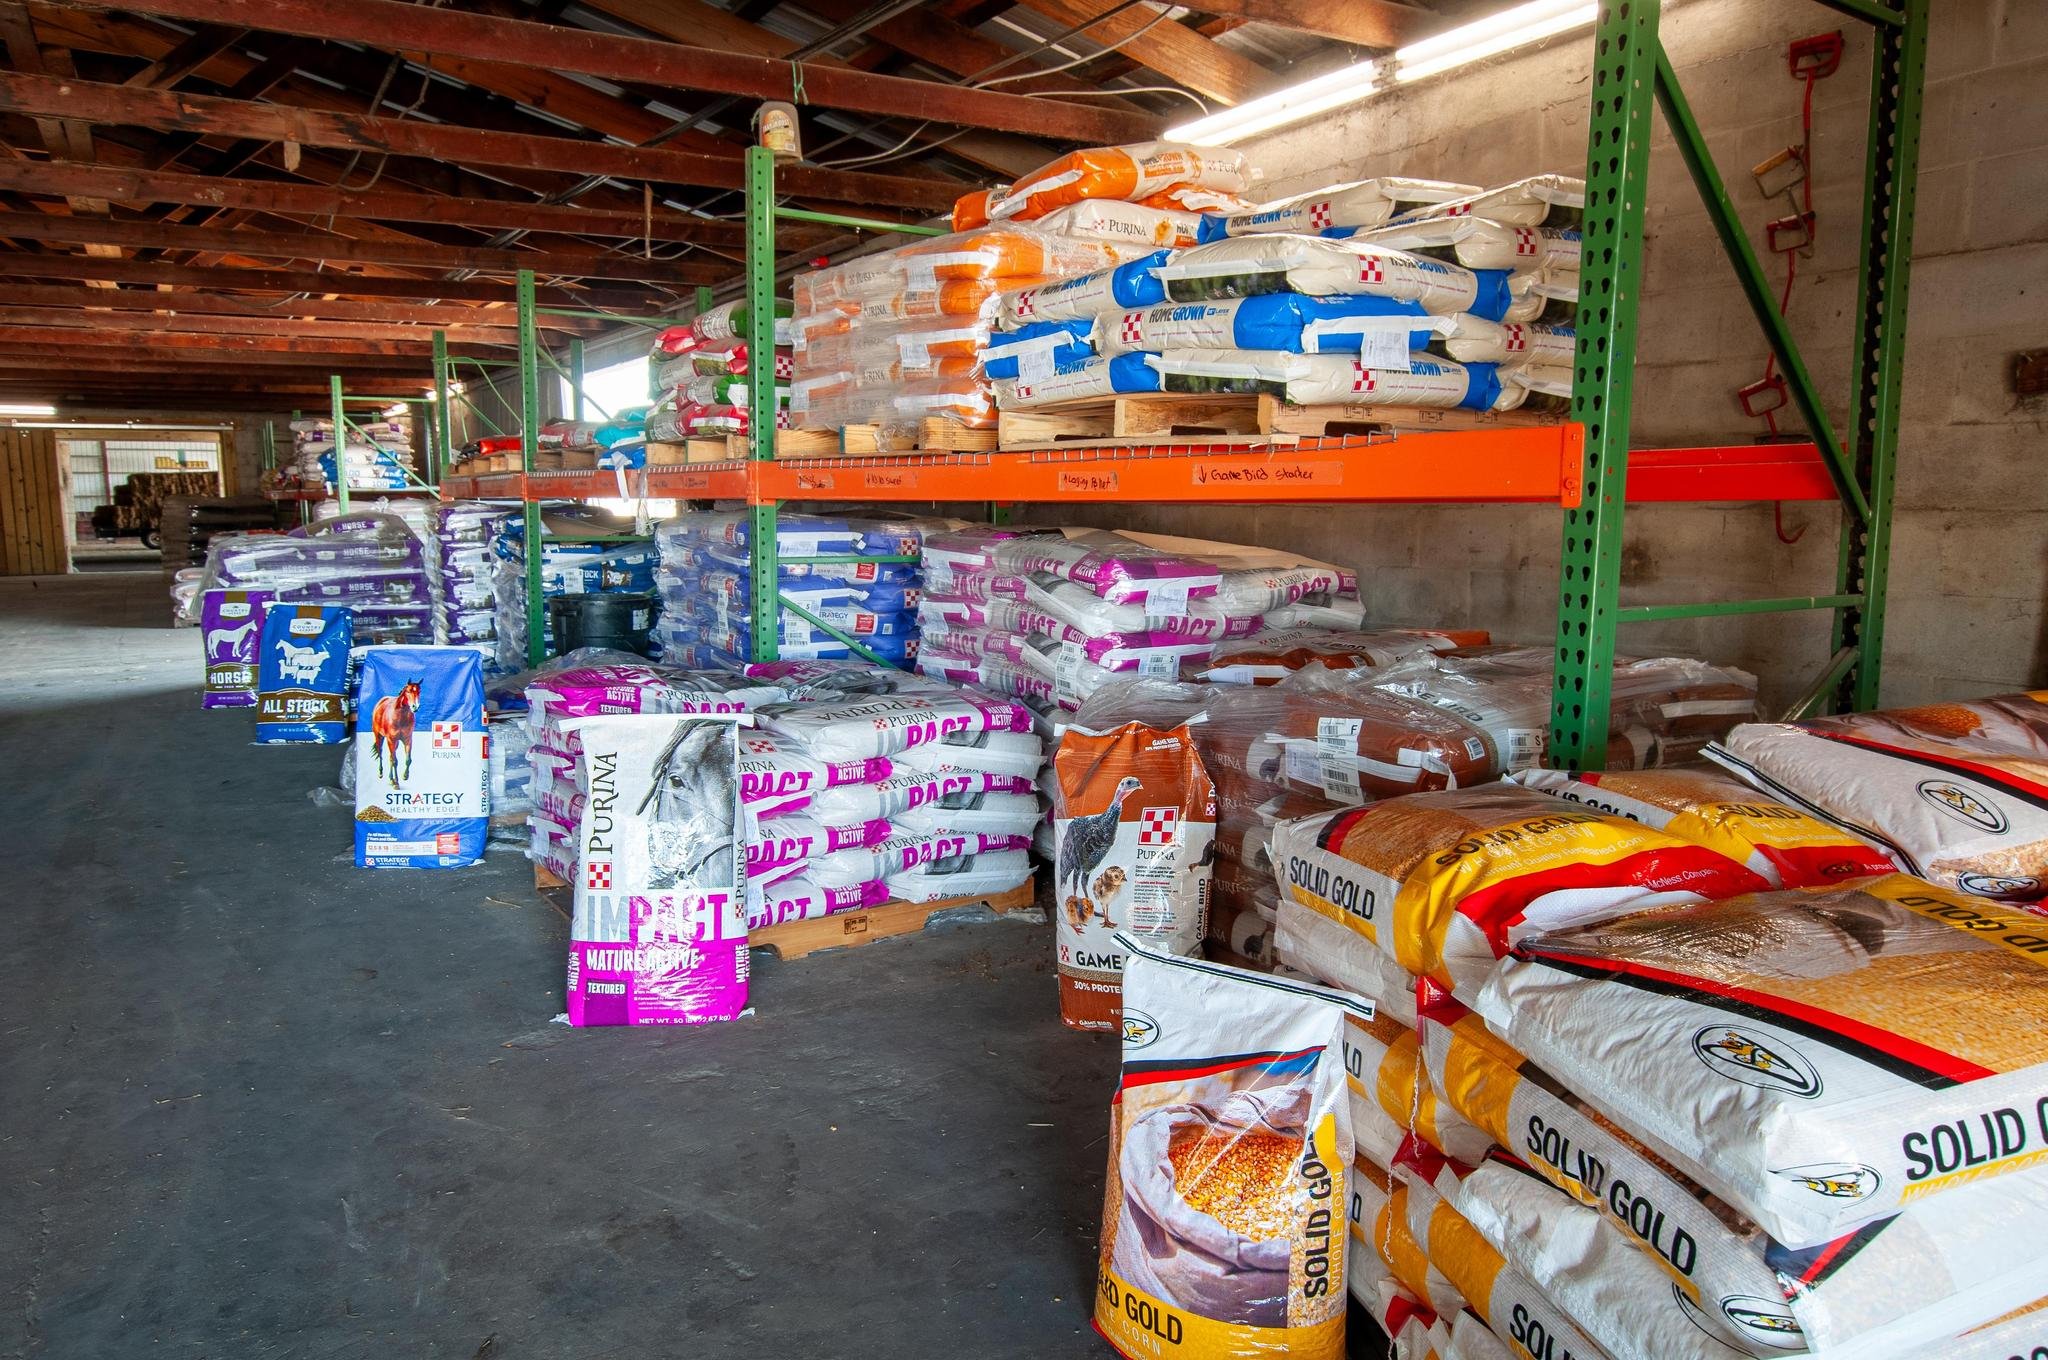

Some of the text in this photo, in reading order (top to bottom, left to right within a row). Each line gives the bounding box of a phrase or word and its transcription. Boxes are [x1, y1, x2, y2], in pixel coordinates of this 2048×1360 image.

[1108, 219, 1147, 236] PURINA
[1211, 468, 1241, 481] Game
[1242, 467, 1268, 481] Bird
[342, 521, 367, 530] HORSE
[343, 547, 370, 556] HORSE
[349, 582, 375, 591] HORSE
[210, 670, 253, 684] HORSE
[607, 690, 635, 703] ACTIVE
[263, 698, 330, 714] ALL STOCK
[985, 705, 1013, 714] MATURE
[888, 711, 938, 728] PURINA
[991, 714, 1013, 726] ACTIVE
[432, 750, 461, 760] PURINA
[837, 767, 866, 781] ACTIVE
[890, 771, 939, 789] PURINA
[991, 775, 1013, 787] ACTIVE
[386, 793, 464, 805] STRATEGY
[588, 752, 618, 855] PURINA
[838, 830, 865, 845] ACTIVE
[883, 834, 932, 851] PURINA
[1436, 828, 1521, 867] SOLID
[736, 839, 745, 899] PURINA
[1198, 878, 1206, 912] BIRD
[1289, 855, 1376, 921] SOLID GOLD
[835, 890, 862, 904] ACTIVE
[587, 893, 728, 943] IMPACT
[586, 949, 643, 972] MATURE
[736, 944, 746, 984] MATURE
[1076, 950, 1122, 970] GAME
[587, 982, 626, 995] TEXTURED
[1074, 980, 1091, 991] 30%
[1903, 1107, 2027, 1181] SOLID
[1526, 1115, 1697, 1277] SOLID GOLD
[1330, 1171, 1344, 1291] WHOLE CORN
[1304, 1208, 1332, 1299] SOLID
[1125, 1292, 1183, 1346] GOLD
[1122, 1320, 1161, 1356] CORN
